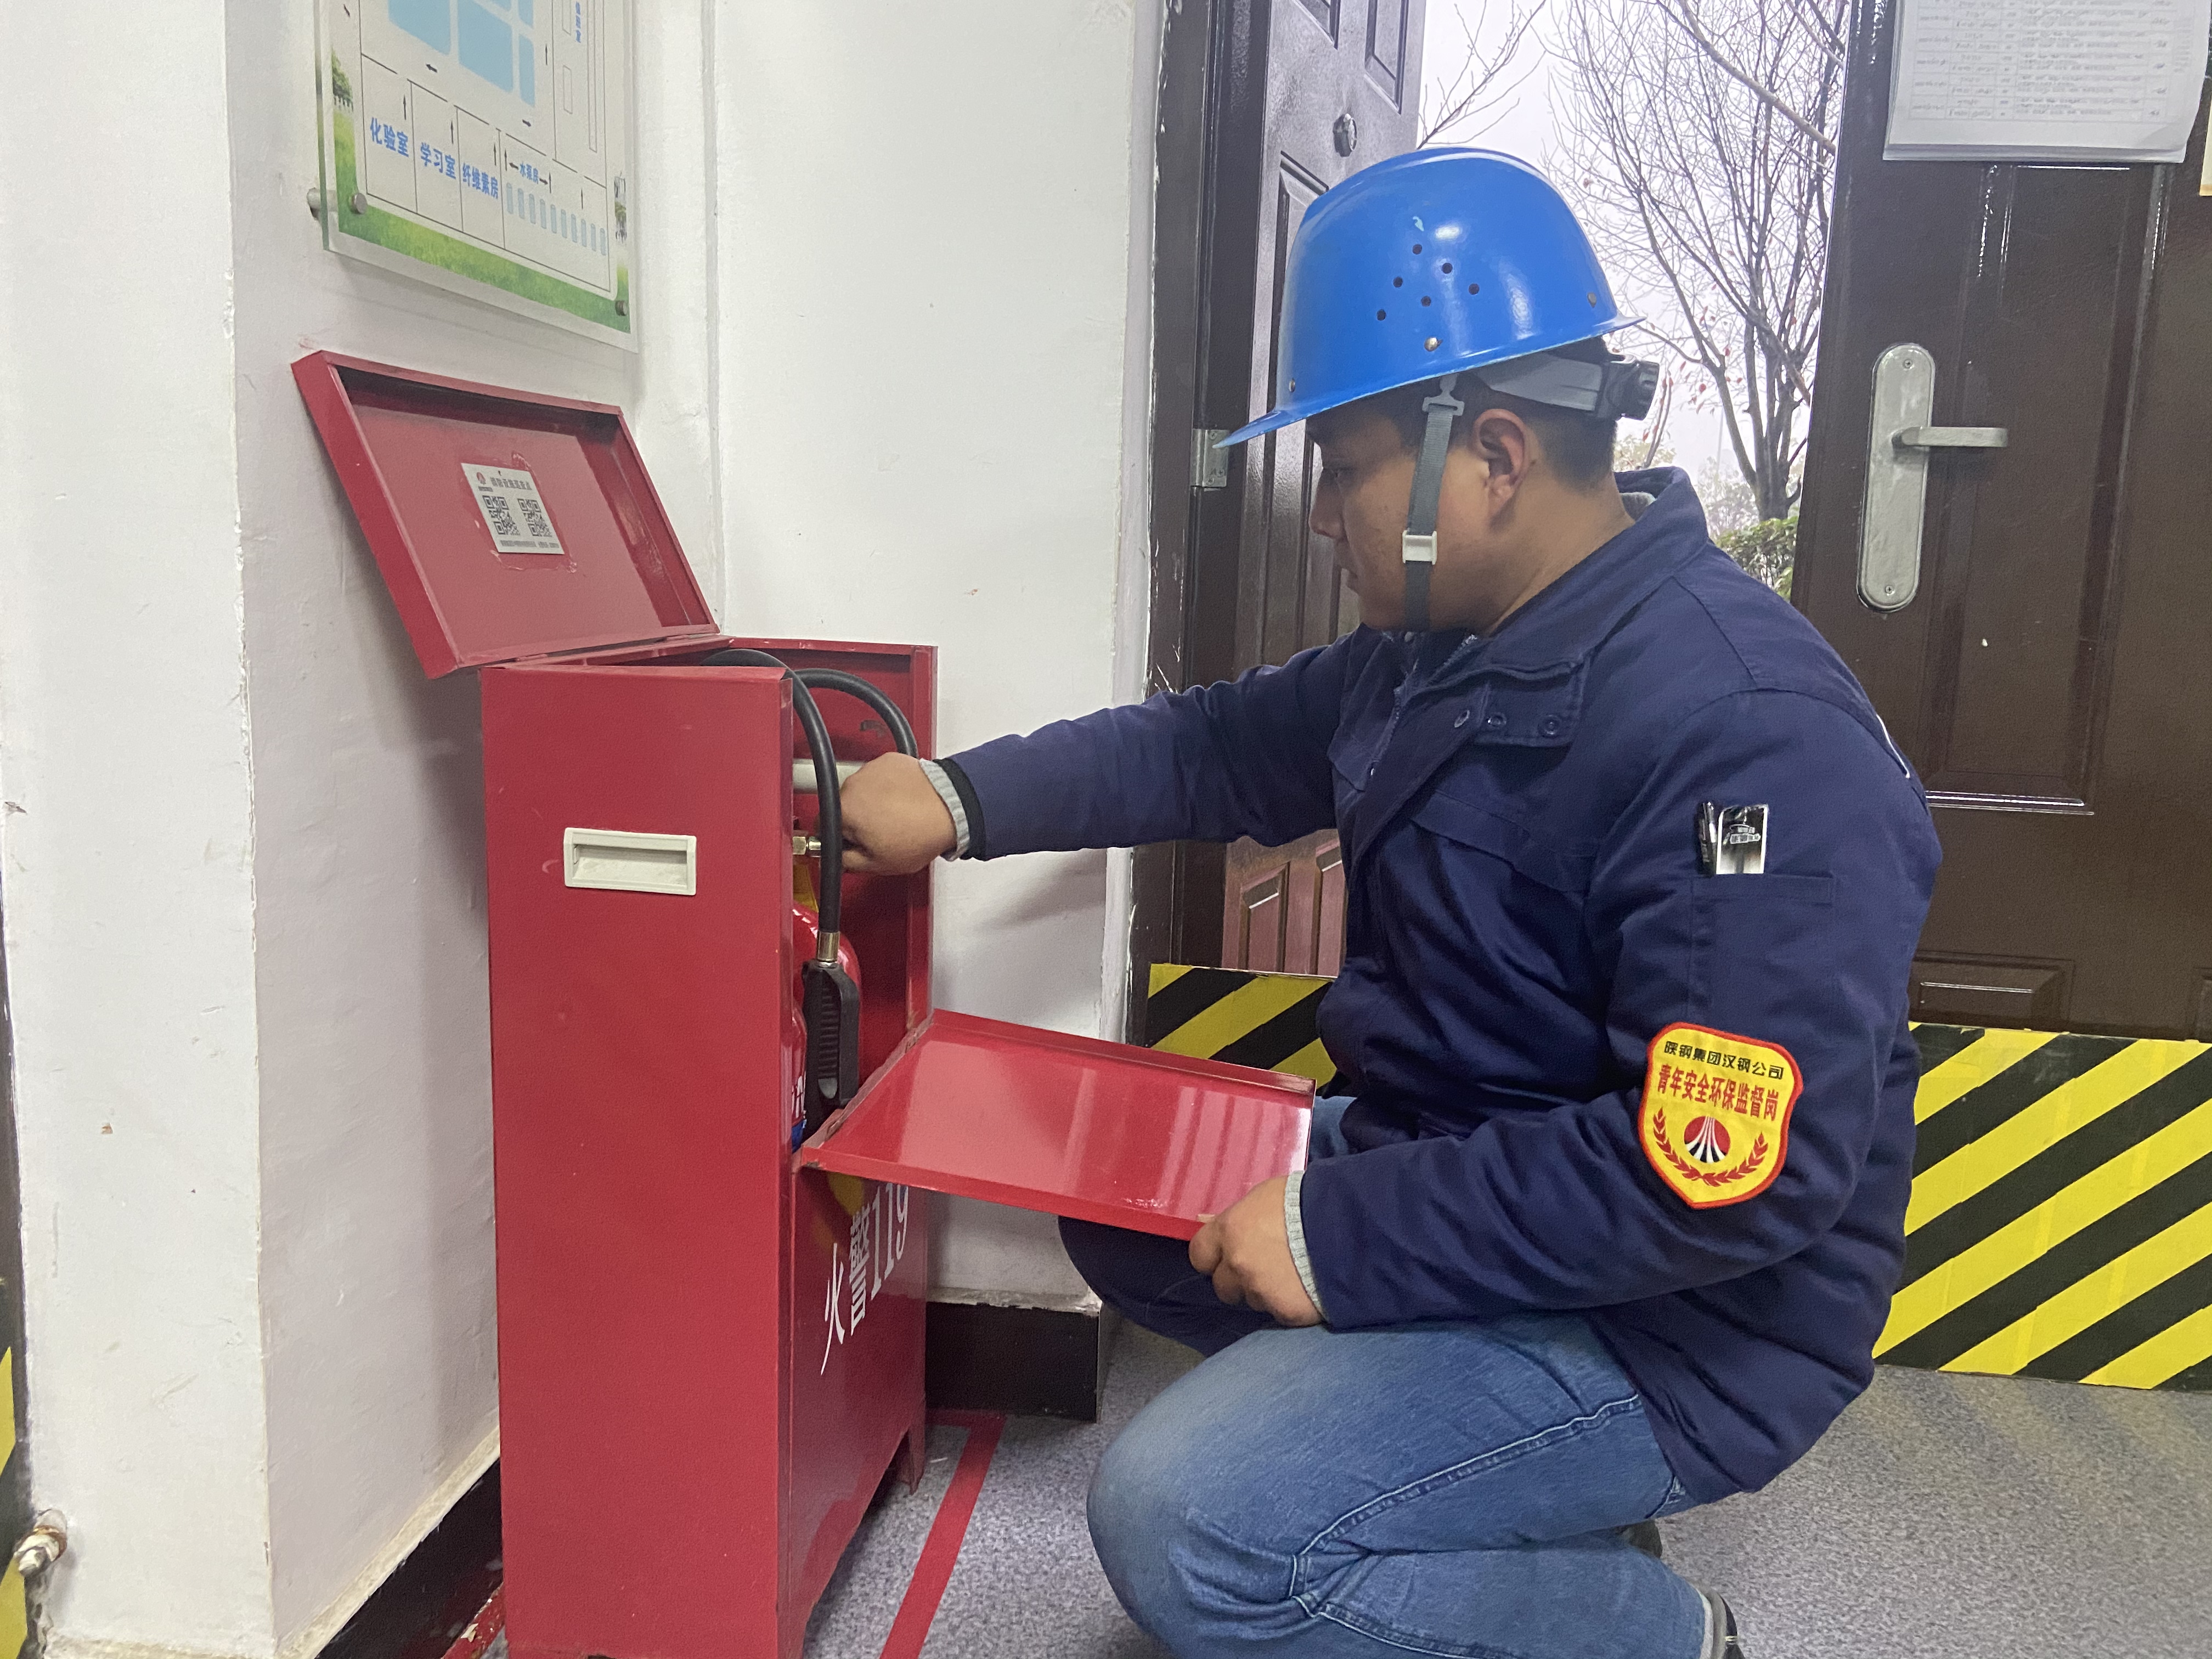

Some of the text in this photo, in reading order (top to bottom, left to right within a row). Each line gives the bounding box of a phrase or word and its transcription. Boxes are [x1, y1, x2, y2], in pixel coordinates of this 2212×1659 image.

[370, 117, 409, 157] 化验室
[420, 142, 456, 179] 学习室
[462, 162, 498, 199] 纤维素房
[1663, 1041, 1784, 1080] 陕钢集团汉钢公司
[1657, 1063, 1779, 1121] 青年安全环保监督岗
